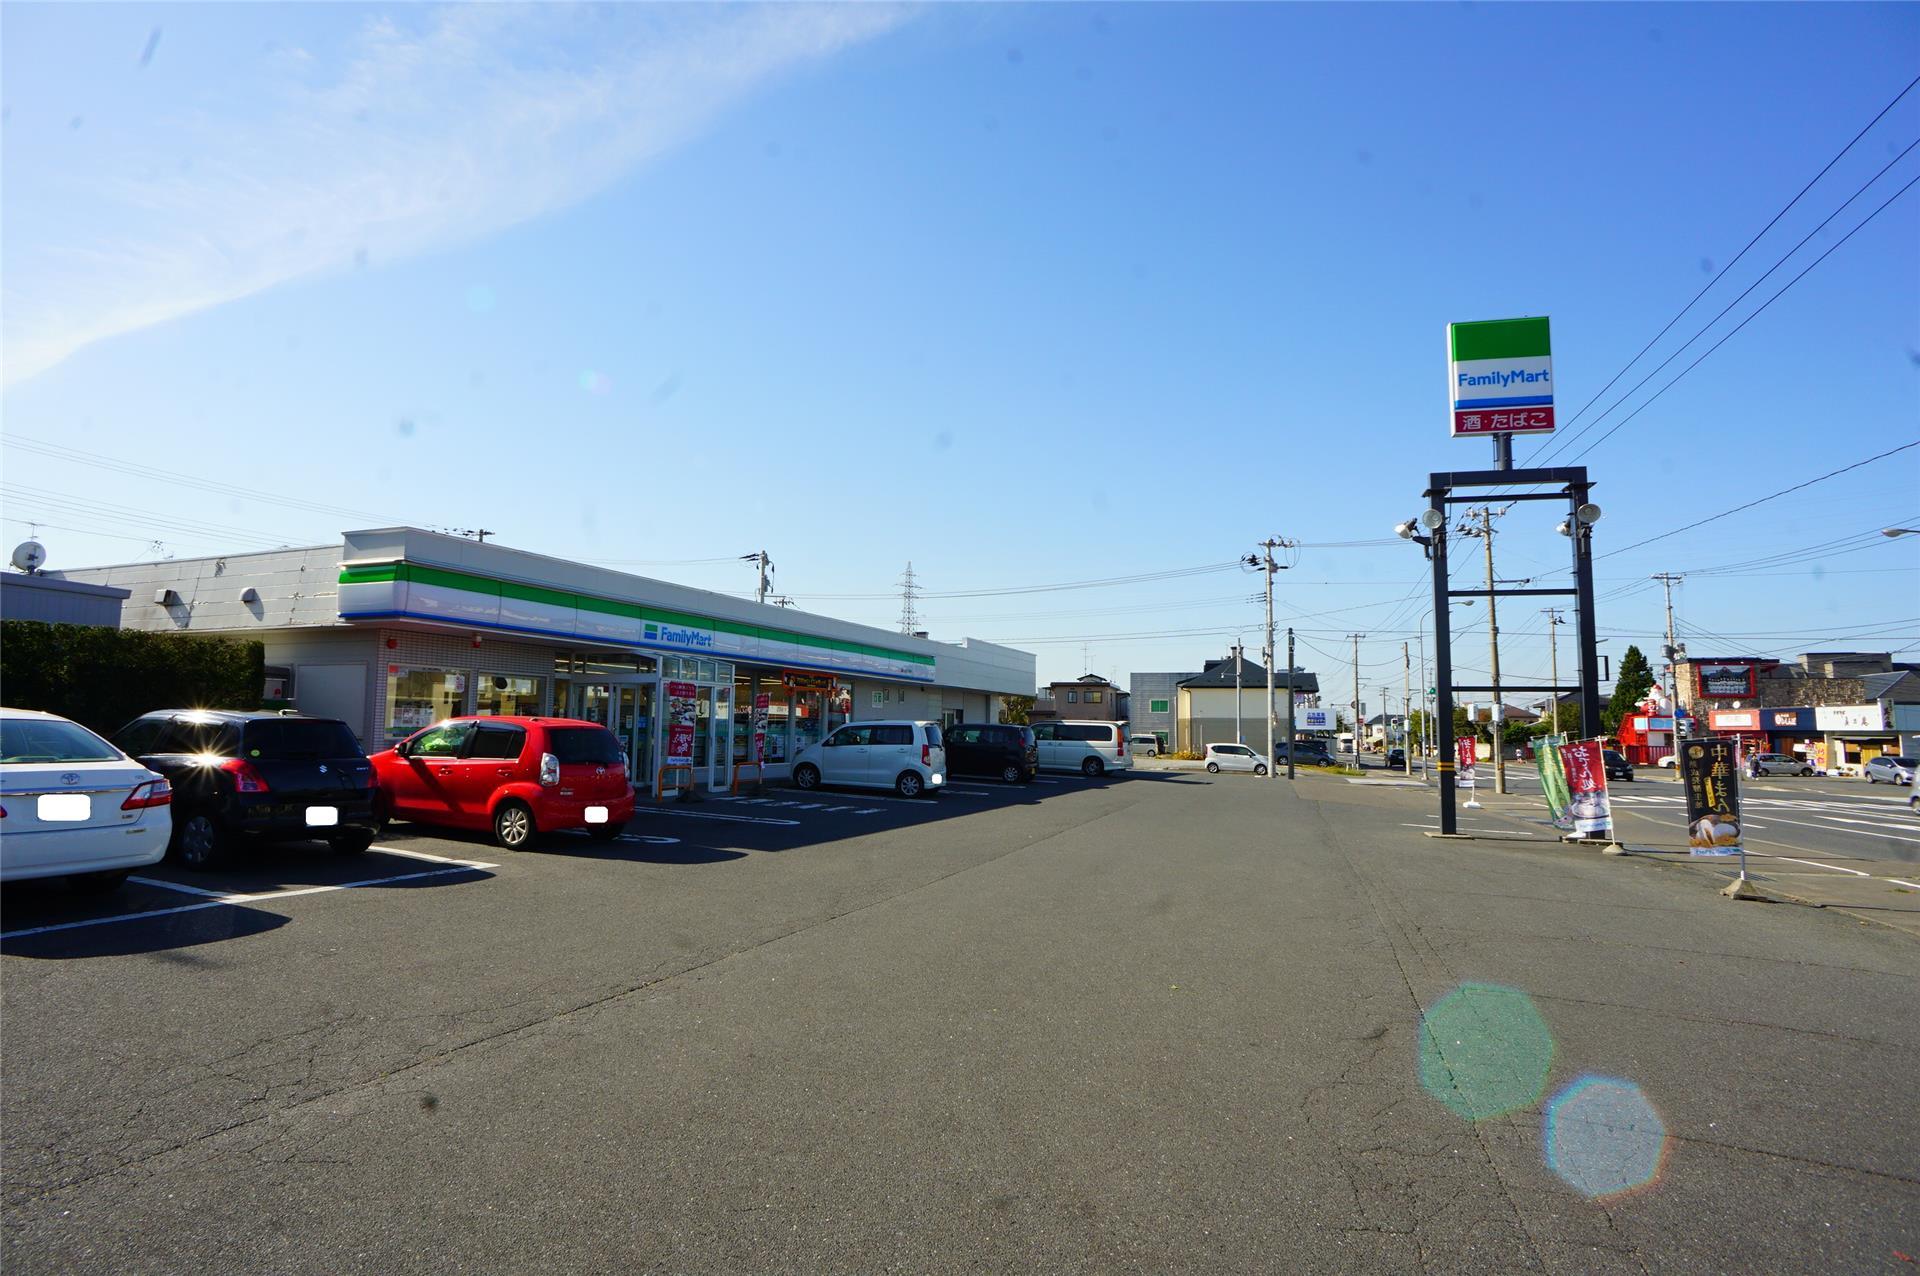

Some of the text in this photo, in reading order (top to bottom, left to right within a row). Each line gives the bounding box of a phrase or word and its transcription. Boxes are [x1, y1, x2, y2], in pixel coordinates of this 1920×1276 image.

[1458, 369, 1549, 388] FamilyMart
[660, 626, 712, 647] FamilyMart
[1711, 743, 1730, 812] 中華まん
